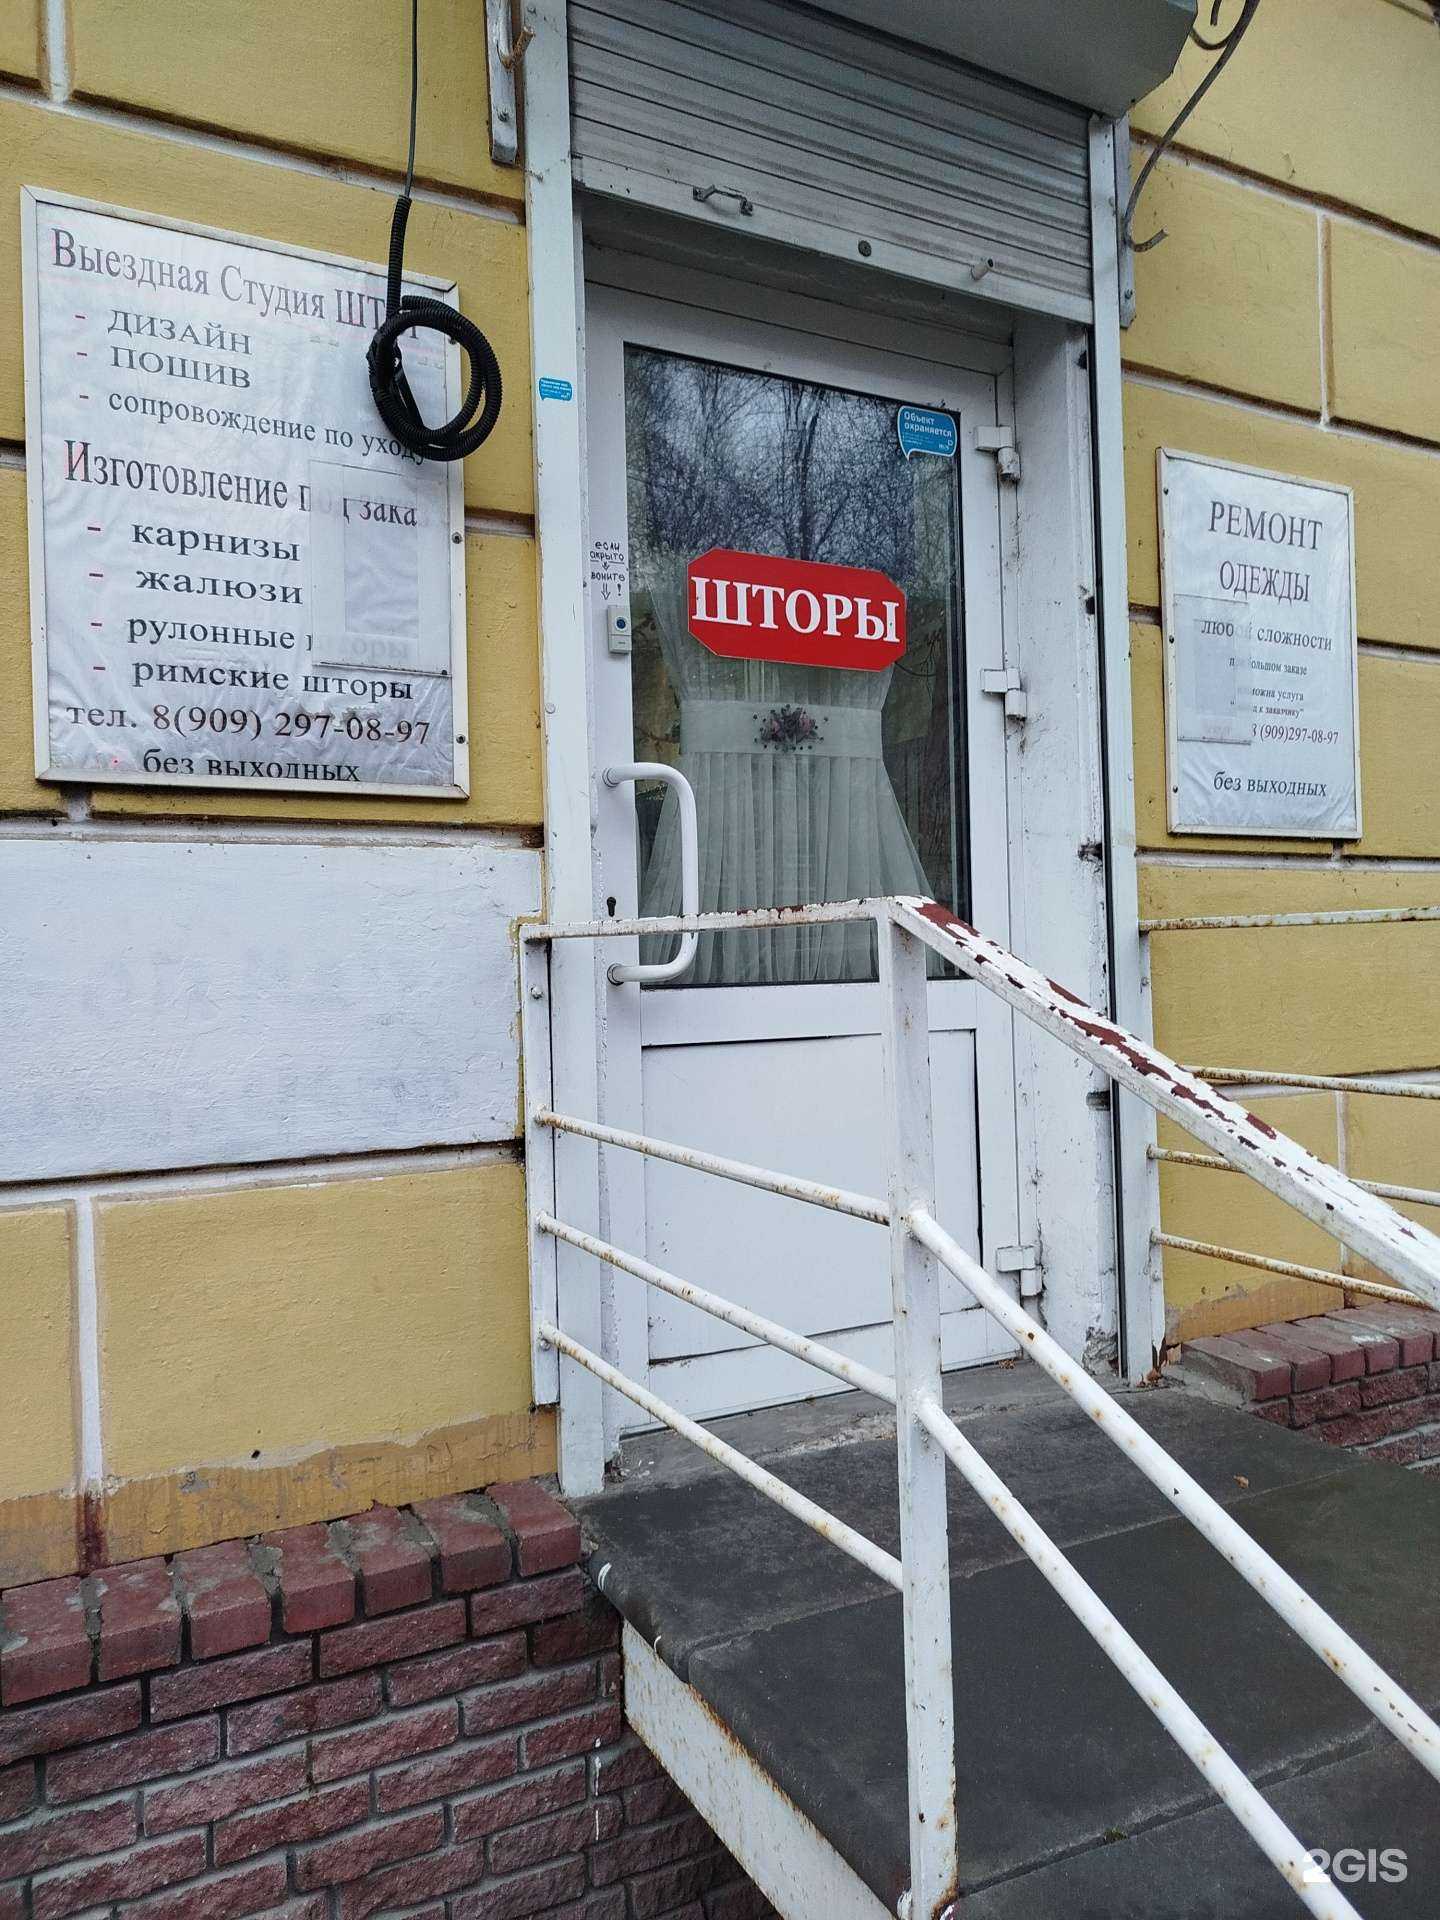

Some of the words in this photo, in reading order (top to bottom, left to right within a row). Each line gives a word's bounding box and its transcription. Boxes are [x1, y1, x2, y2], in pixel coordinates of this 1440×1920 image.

[51, 227, 209, 296] Выездная
[220, 265, 325, 320] Студия
[108, 389, 315, 441] сопровождение
[325, 429, 354, 448] по
[904, 422, 952, 438] охраняется
[64, 439, 289, 509] Изготовление
[132, 523, 301, 562] карнизы
[1208, 500, 1323, 550] РЕМОНТ
[135, 570, 303, 605] жалюзи
[1219, 560, 1310, 602] ОДЕЖДЫ
[691, 576, 900, 643] ШТОРЫ
[128, 617, 295, 651] рулонные
[1257, 628, 1332, 651] сложности
[132, 661, 289, 691] римские
[302, 675, 414, 704] шторы
[66, 704, 137, 729] тел.
[153, 704, 262, 741] 8(909)
[274, 712, 430, 746] 297-08-97
[1260, 723, 1339, 744] (909)297-08-97
[143, 748, 194, 775] без
[207, 759, 360, 782] выходных
[1213, 771, 1241, 792] без
[1247, 779, 1326, 797] выходных
